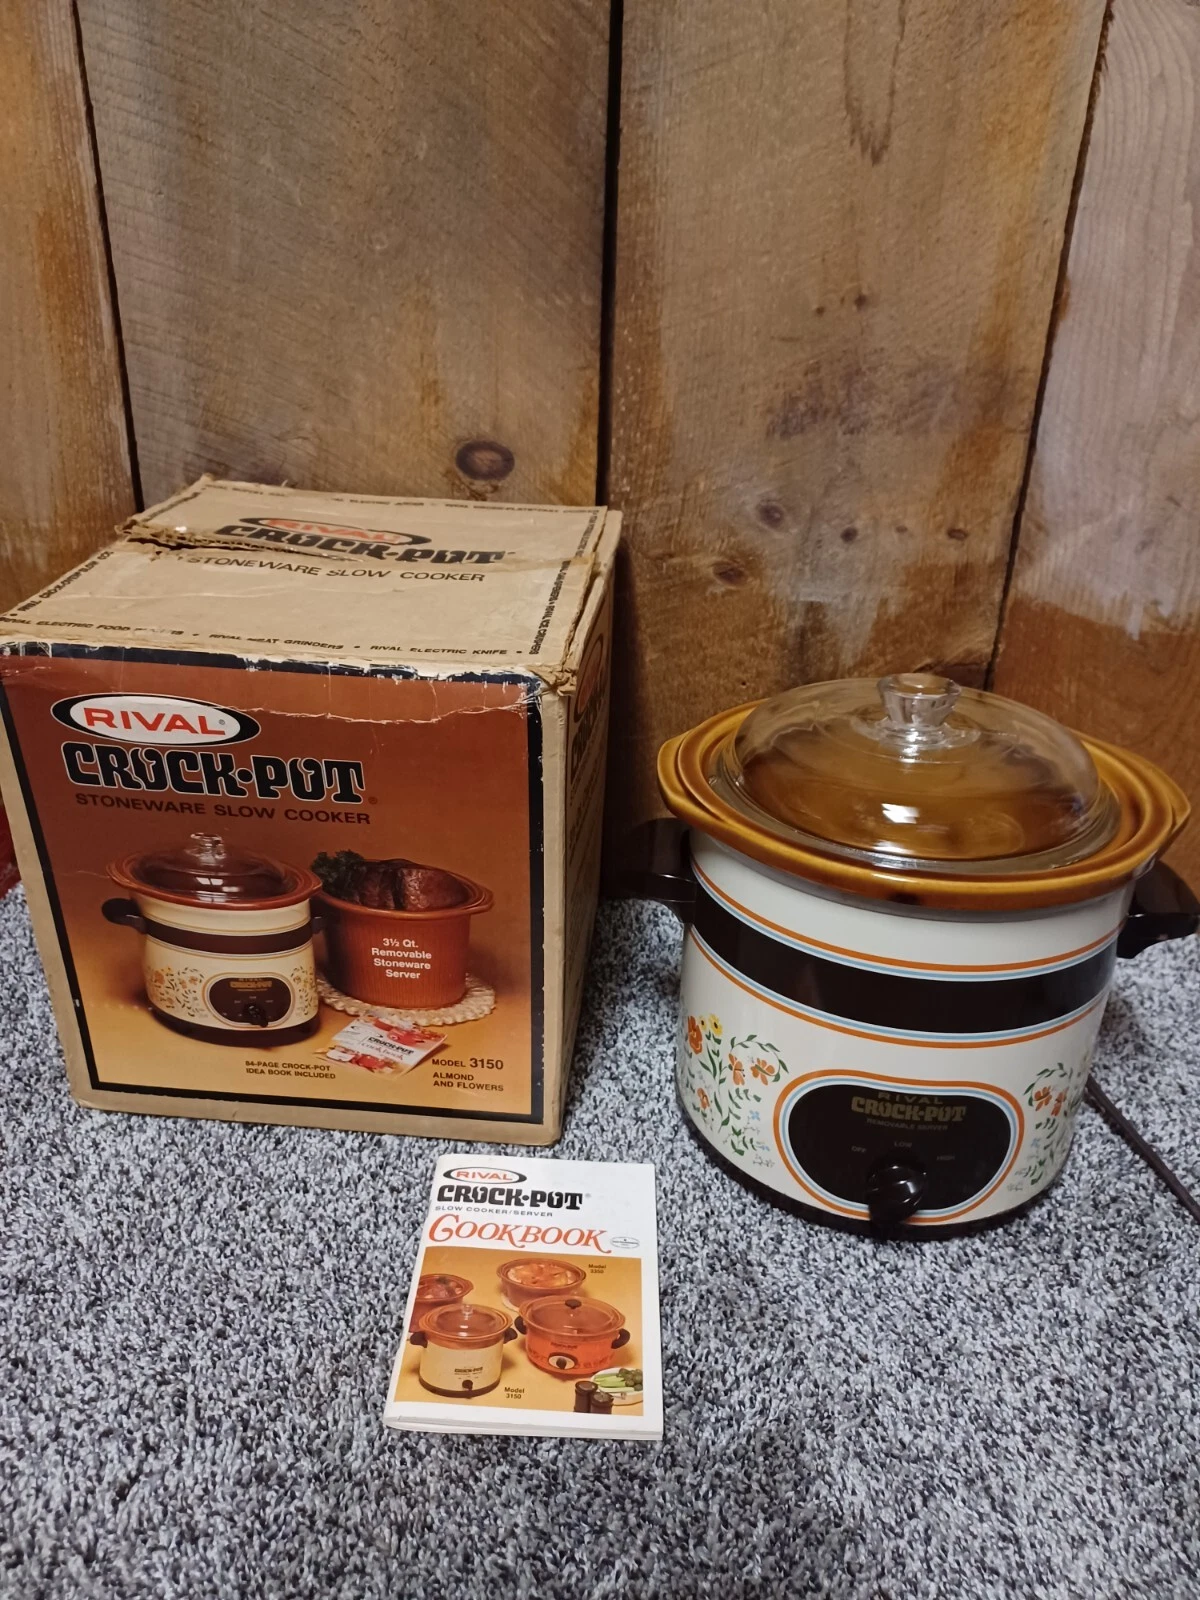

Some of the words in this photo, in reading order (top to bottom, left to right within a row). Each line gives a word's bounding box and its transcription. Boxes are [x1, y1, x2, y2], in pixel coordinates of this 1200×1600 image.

[266, 518, 401, 544] RIVAL
[187, 556, 321, 576] STONEWARE
[326, 568, 391, 578] SLOW
[400, 571, 485, 581] COOKER
[36, 620, 94, 629] ELECTRIC
[96, 624, 131, 632] FOOD
[284, 639, 344, 650] GRINDERS
[410, 646, 468, 655] ELECTRIC
[83, 707, 226, 736] RIVAL
[75, 793, 207, 815] STONEWARE
[214, 804, 275, 819] SLOW
[283, 809, 371, 825] COOKER
[402, 939, 419, 948] Qt.
[371, 947, 432, 960] Removable
[373, 958, 431, 970] Stoneware
[385, 969, 421, 979] Server
[281, 1062, 331, 1072] CROCK-POT
[431, 1058, 466, 1068] MODEL
[469, 1057, 504, 1070] 3150
[268, 1068, 292, 1076] BOOK
[294, 1071, 336, 1080] INCLUDED
[432, 1071, 474, 1081] ALMOND
[433, 1080, 454, 1088] AND
[456, 1082, 504, 1092] FLOWERS
[877, 1091, 944, 1105] RIVAL
[866, 1118, 915, 1131] REMOVABLE
[851, 1145, 867, 1153] OFF
[894, 1140, 913, 1148] LOW
[456, 1168, 514, 1182] RIVAL
[466, 1206, 553, 1217] COOKER/SERVER
[504, 1386, 525, 1394] Model
